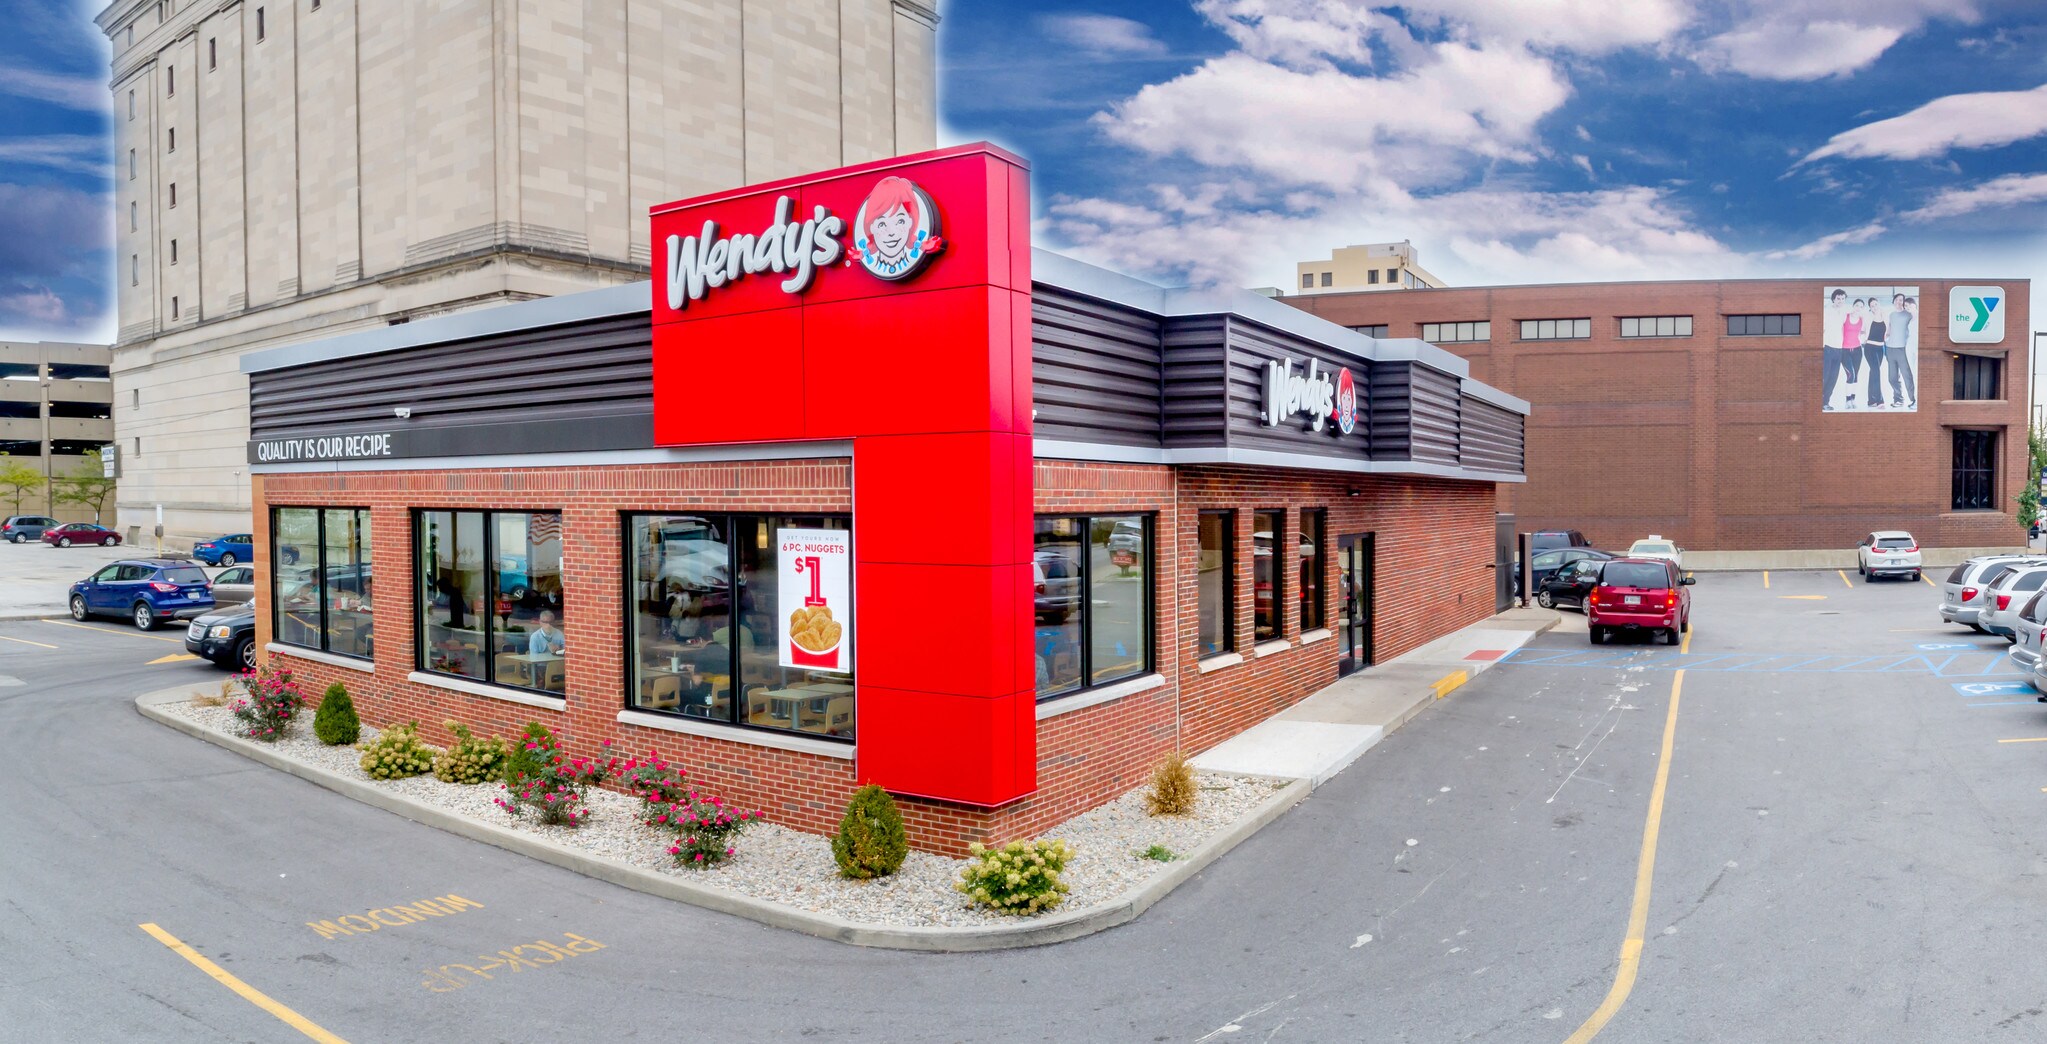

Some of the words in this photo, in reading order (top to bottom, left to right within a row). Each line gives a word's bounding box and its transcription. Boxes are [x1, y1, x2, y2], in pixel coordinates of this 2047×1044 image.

[666, 195, 843, 311] Wendy's
[1955, 314, 1970, 322] the
[1268, 357, 1334, 432] Wendy's
[257, 440, 303, 462] QUALITY
[305, 439, 316, 459] IS
[317, 437, 343, 458] OUR
[345, 433, 392, 457] RECIPE
[782, 543, 788, 552] 6
[804, 543, 845, 554] NUGGETS
[306, 893, 485, 941] WINDOW
[421, 932, 608, 993] PICK-UP
